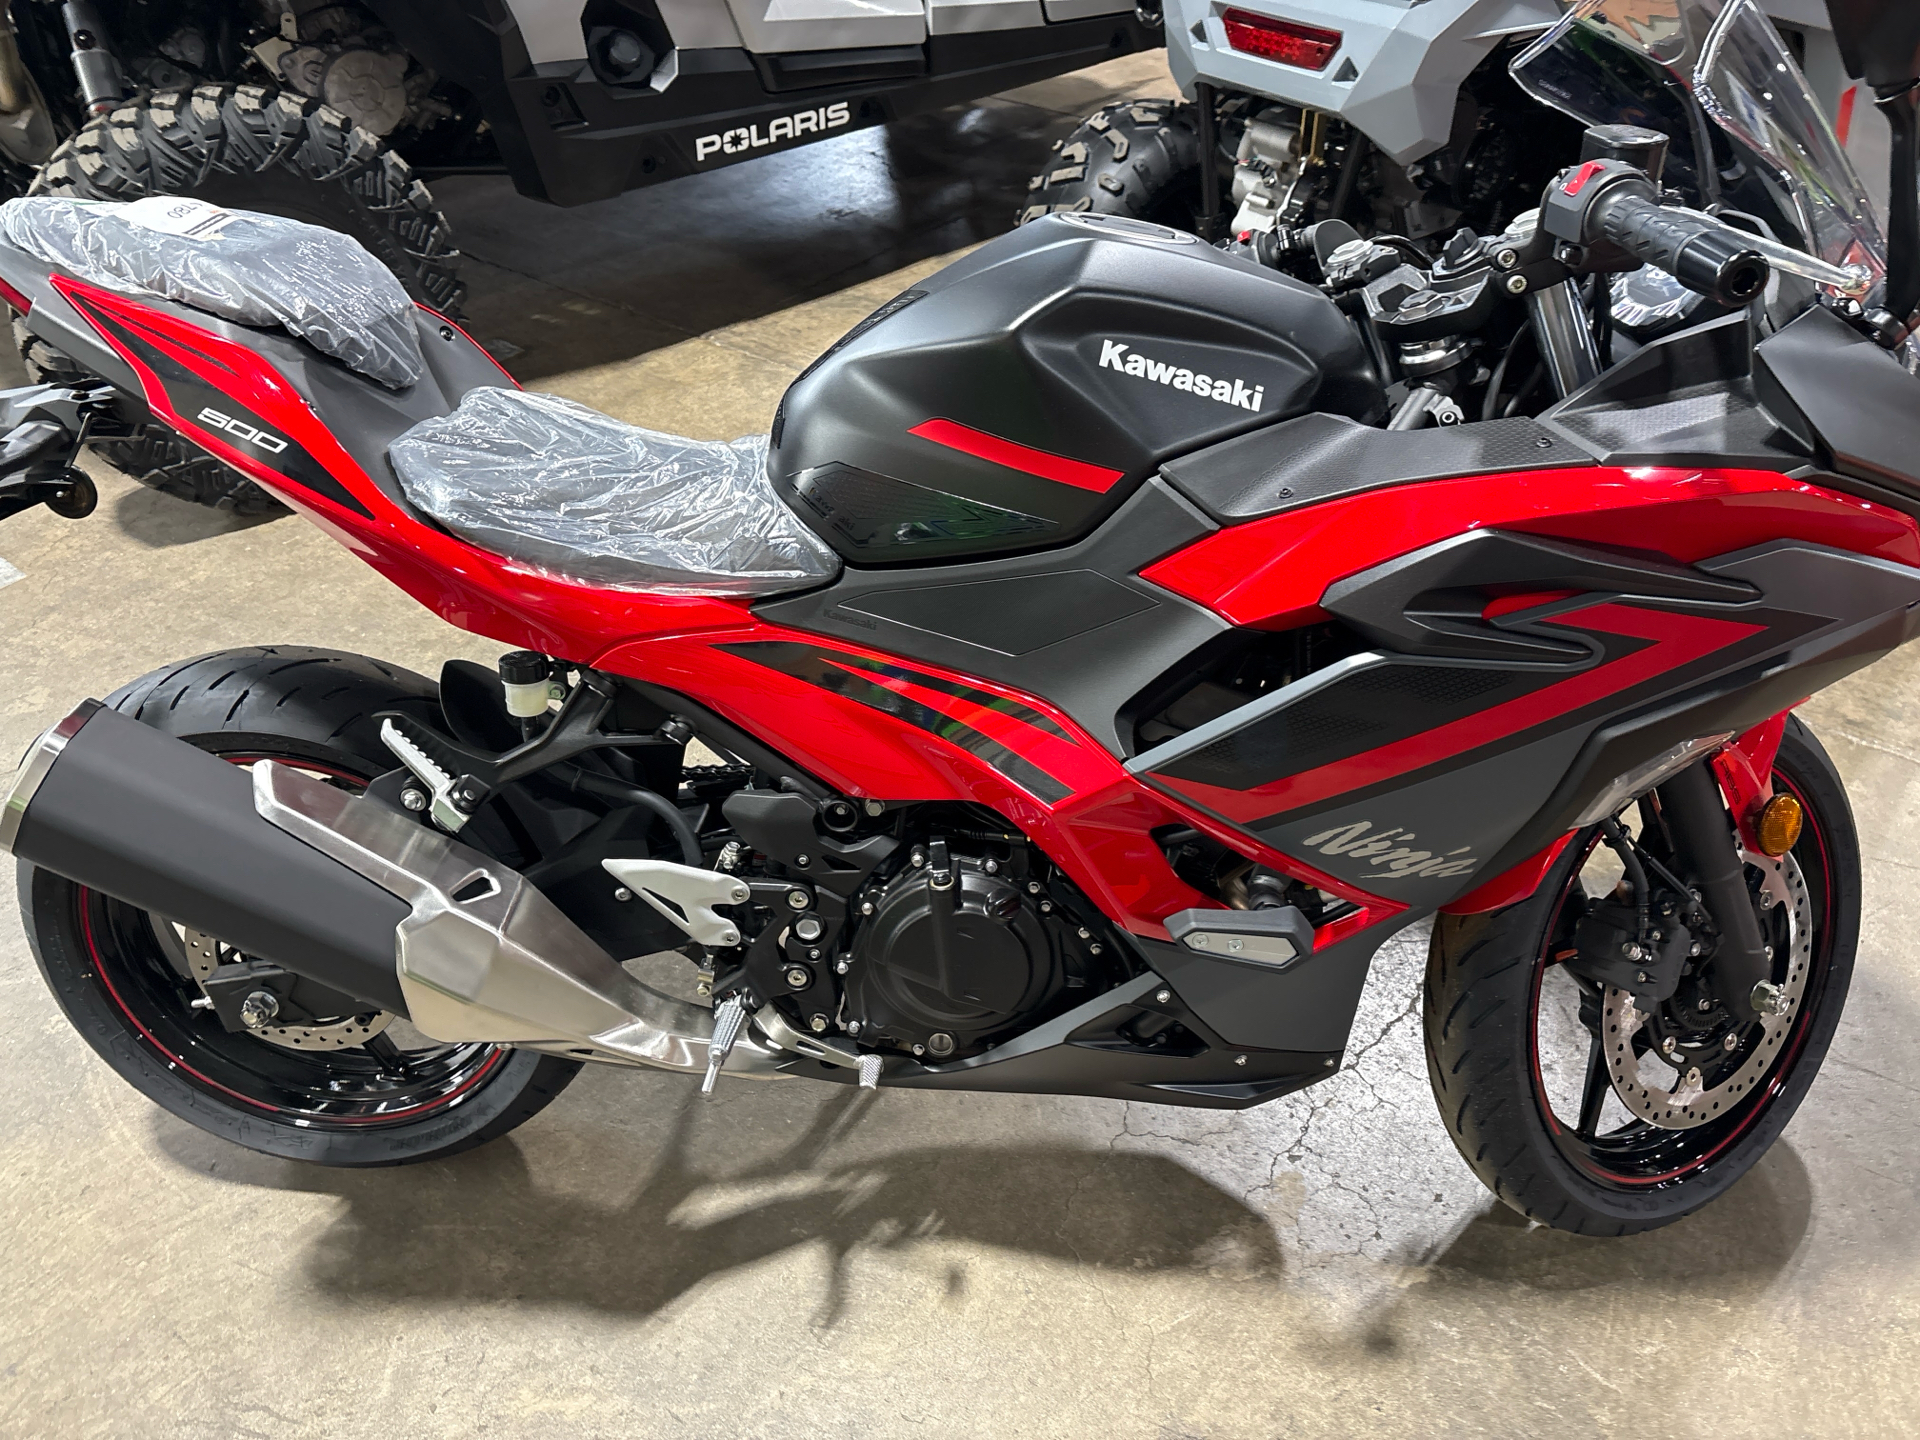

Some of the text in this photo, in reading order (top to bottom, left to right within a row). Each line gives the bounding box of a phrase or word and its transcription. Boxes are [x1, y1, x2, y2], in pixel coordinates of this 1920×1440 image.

[695, 101, 850, 162] POLARIS
[1098, 339, 1265, 412] Kawasaki
[196, 406, 289, 454] 500
[822, 609, 877, 631] Kawasaki
[1302, 820, 1478, 878] Ninja
